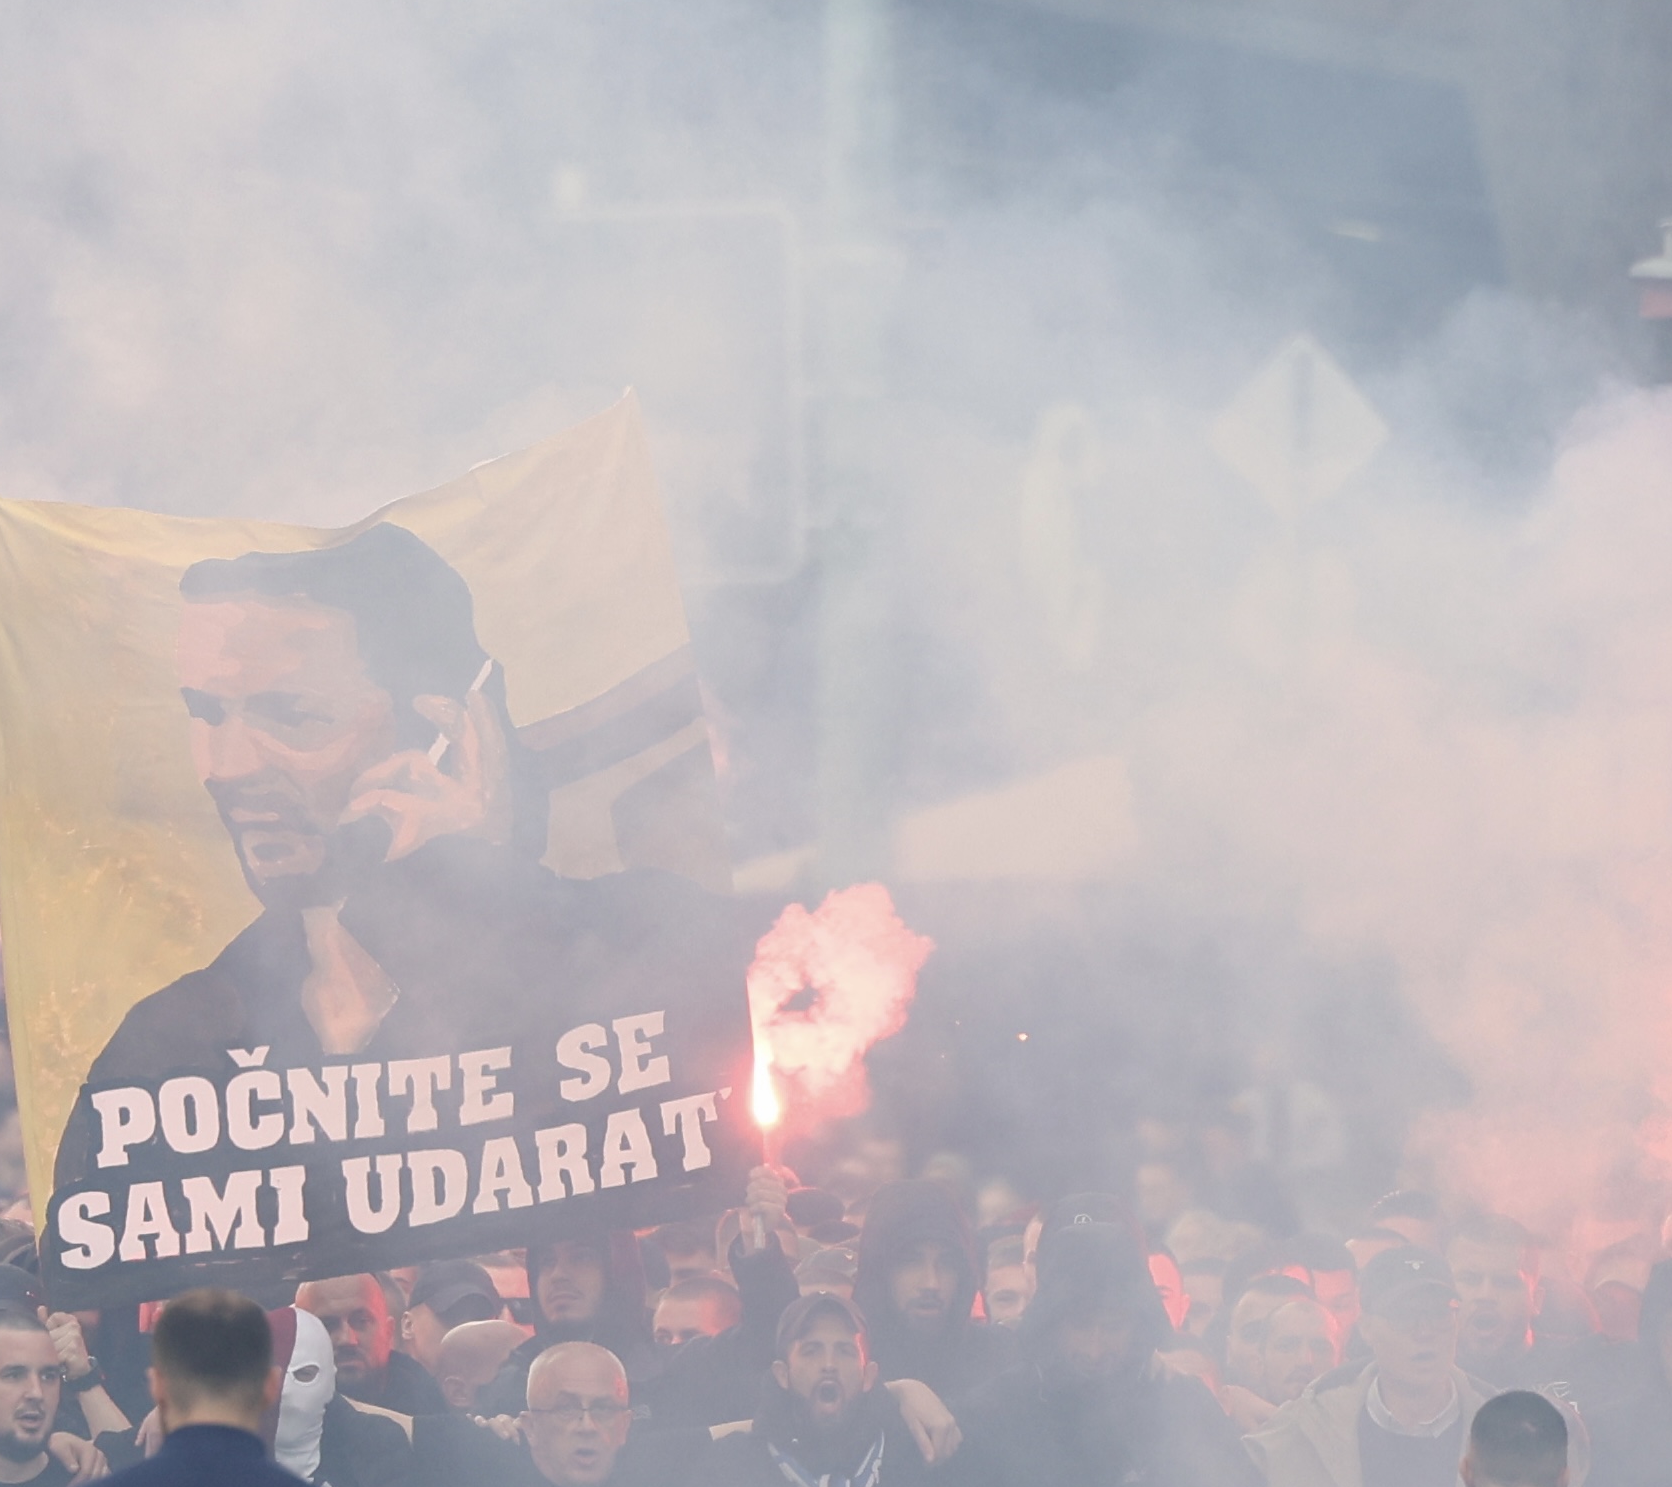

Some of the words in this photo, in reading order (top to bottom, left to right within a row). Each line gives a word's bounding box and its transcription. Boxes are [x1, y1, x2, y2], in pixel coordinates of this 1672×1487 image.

[91, 1046, 514, 1168] POČNITE
[556, 1010, 672, 1102] SE
[59, 1165, 310, 1270] SAMI
[342, 1087, 734, 1234] UDARAT
